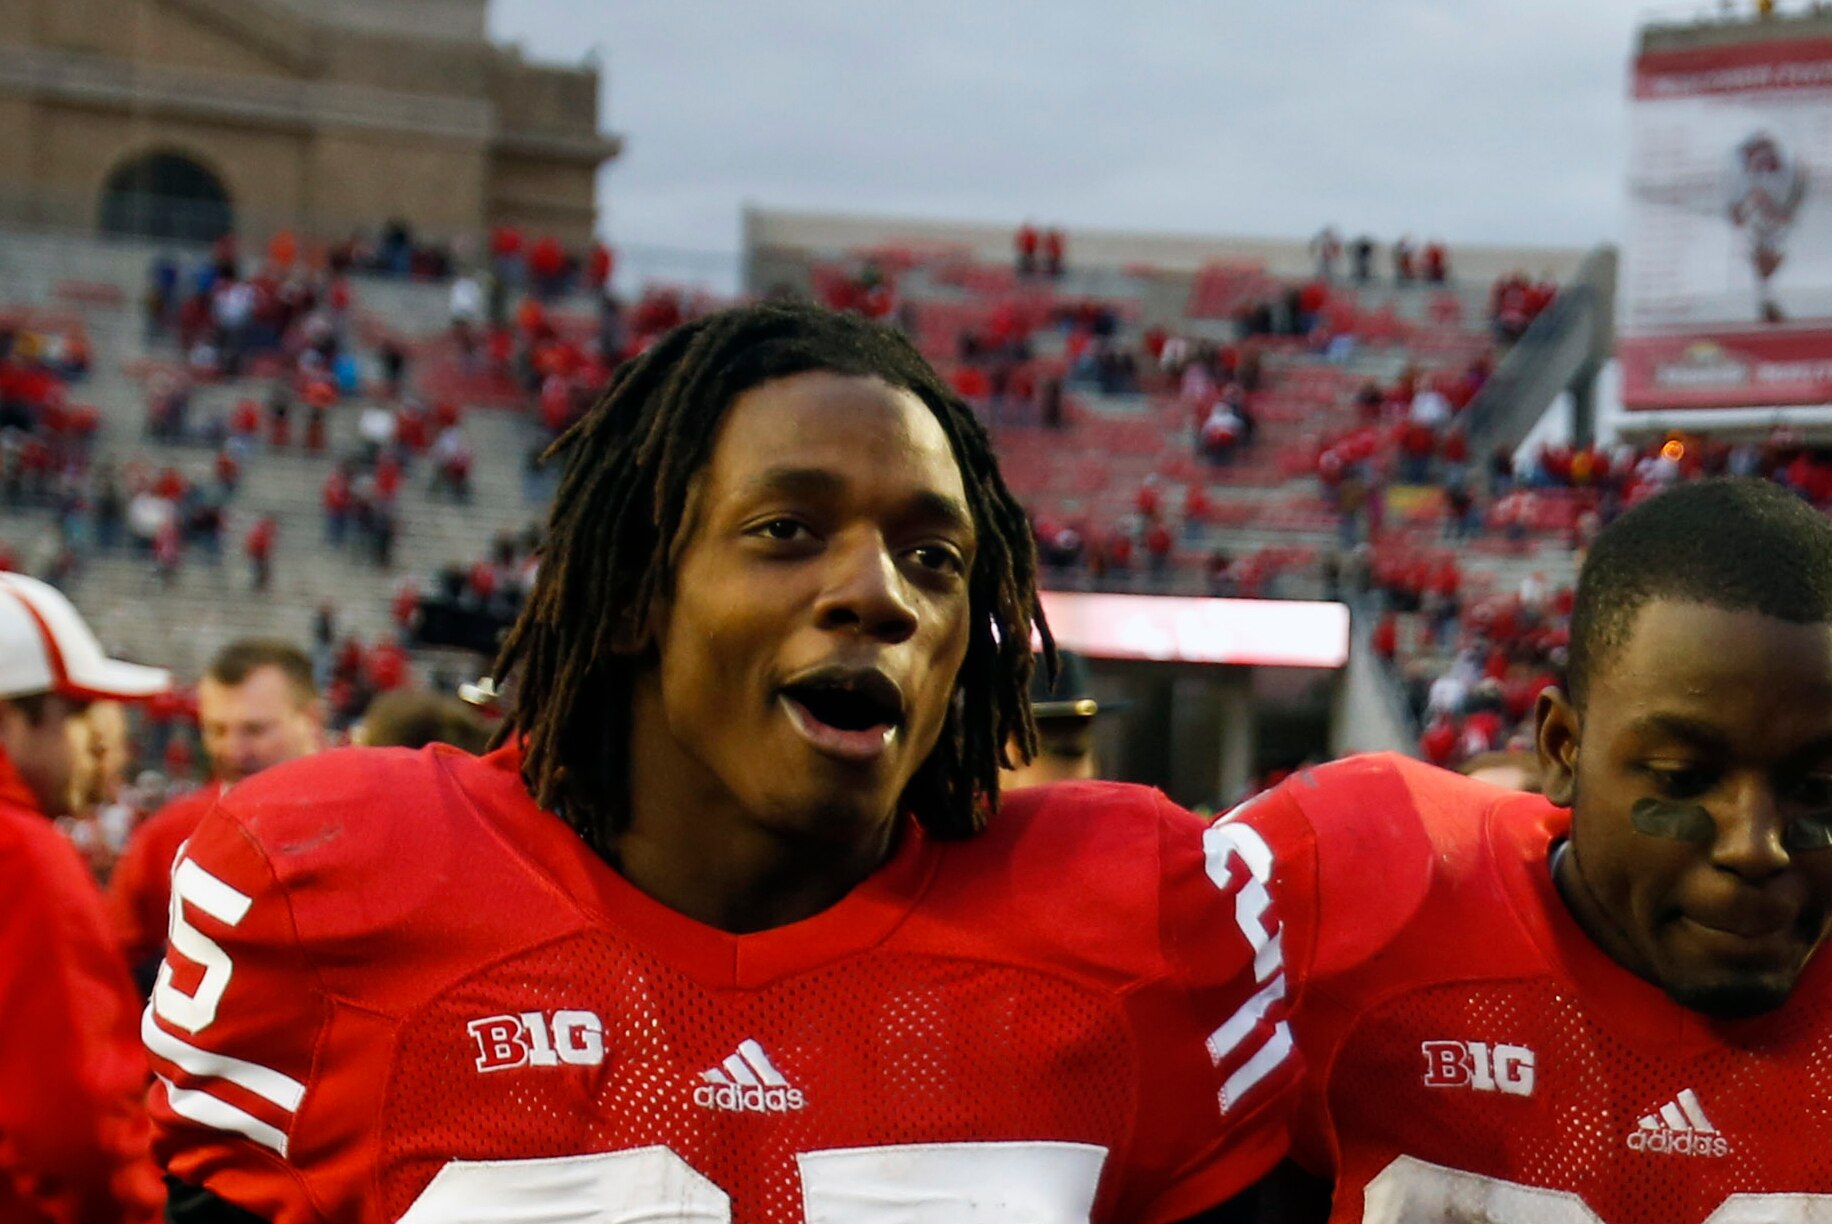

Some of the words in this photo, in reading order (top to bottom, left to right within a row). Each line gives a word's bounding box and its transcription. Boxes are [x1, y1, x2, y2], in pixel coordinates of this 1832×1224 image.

[149, 838, 253, 1035] 5
[693, 1080, 804, 1113] adidas
[1626, 1128, 1728, 1158] adidas
